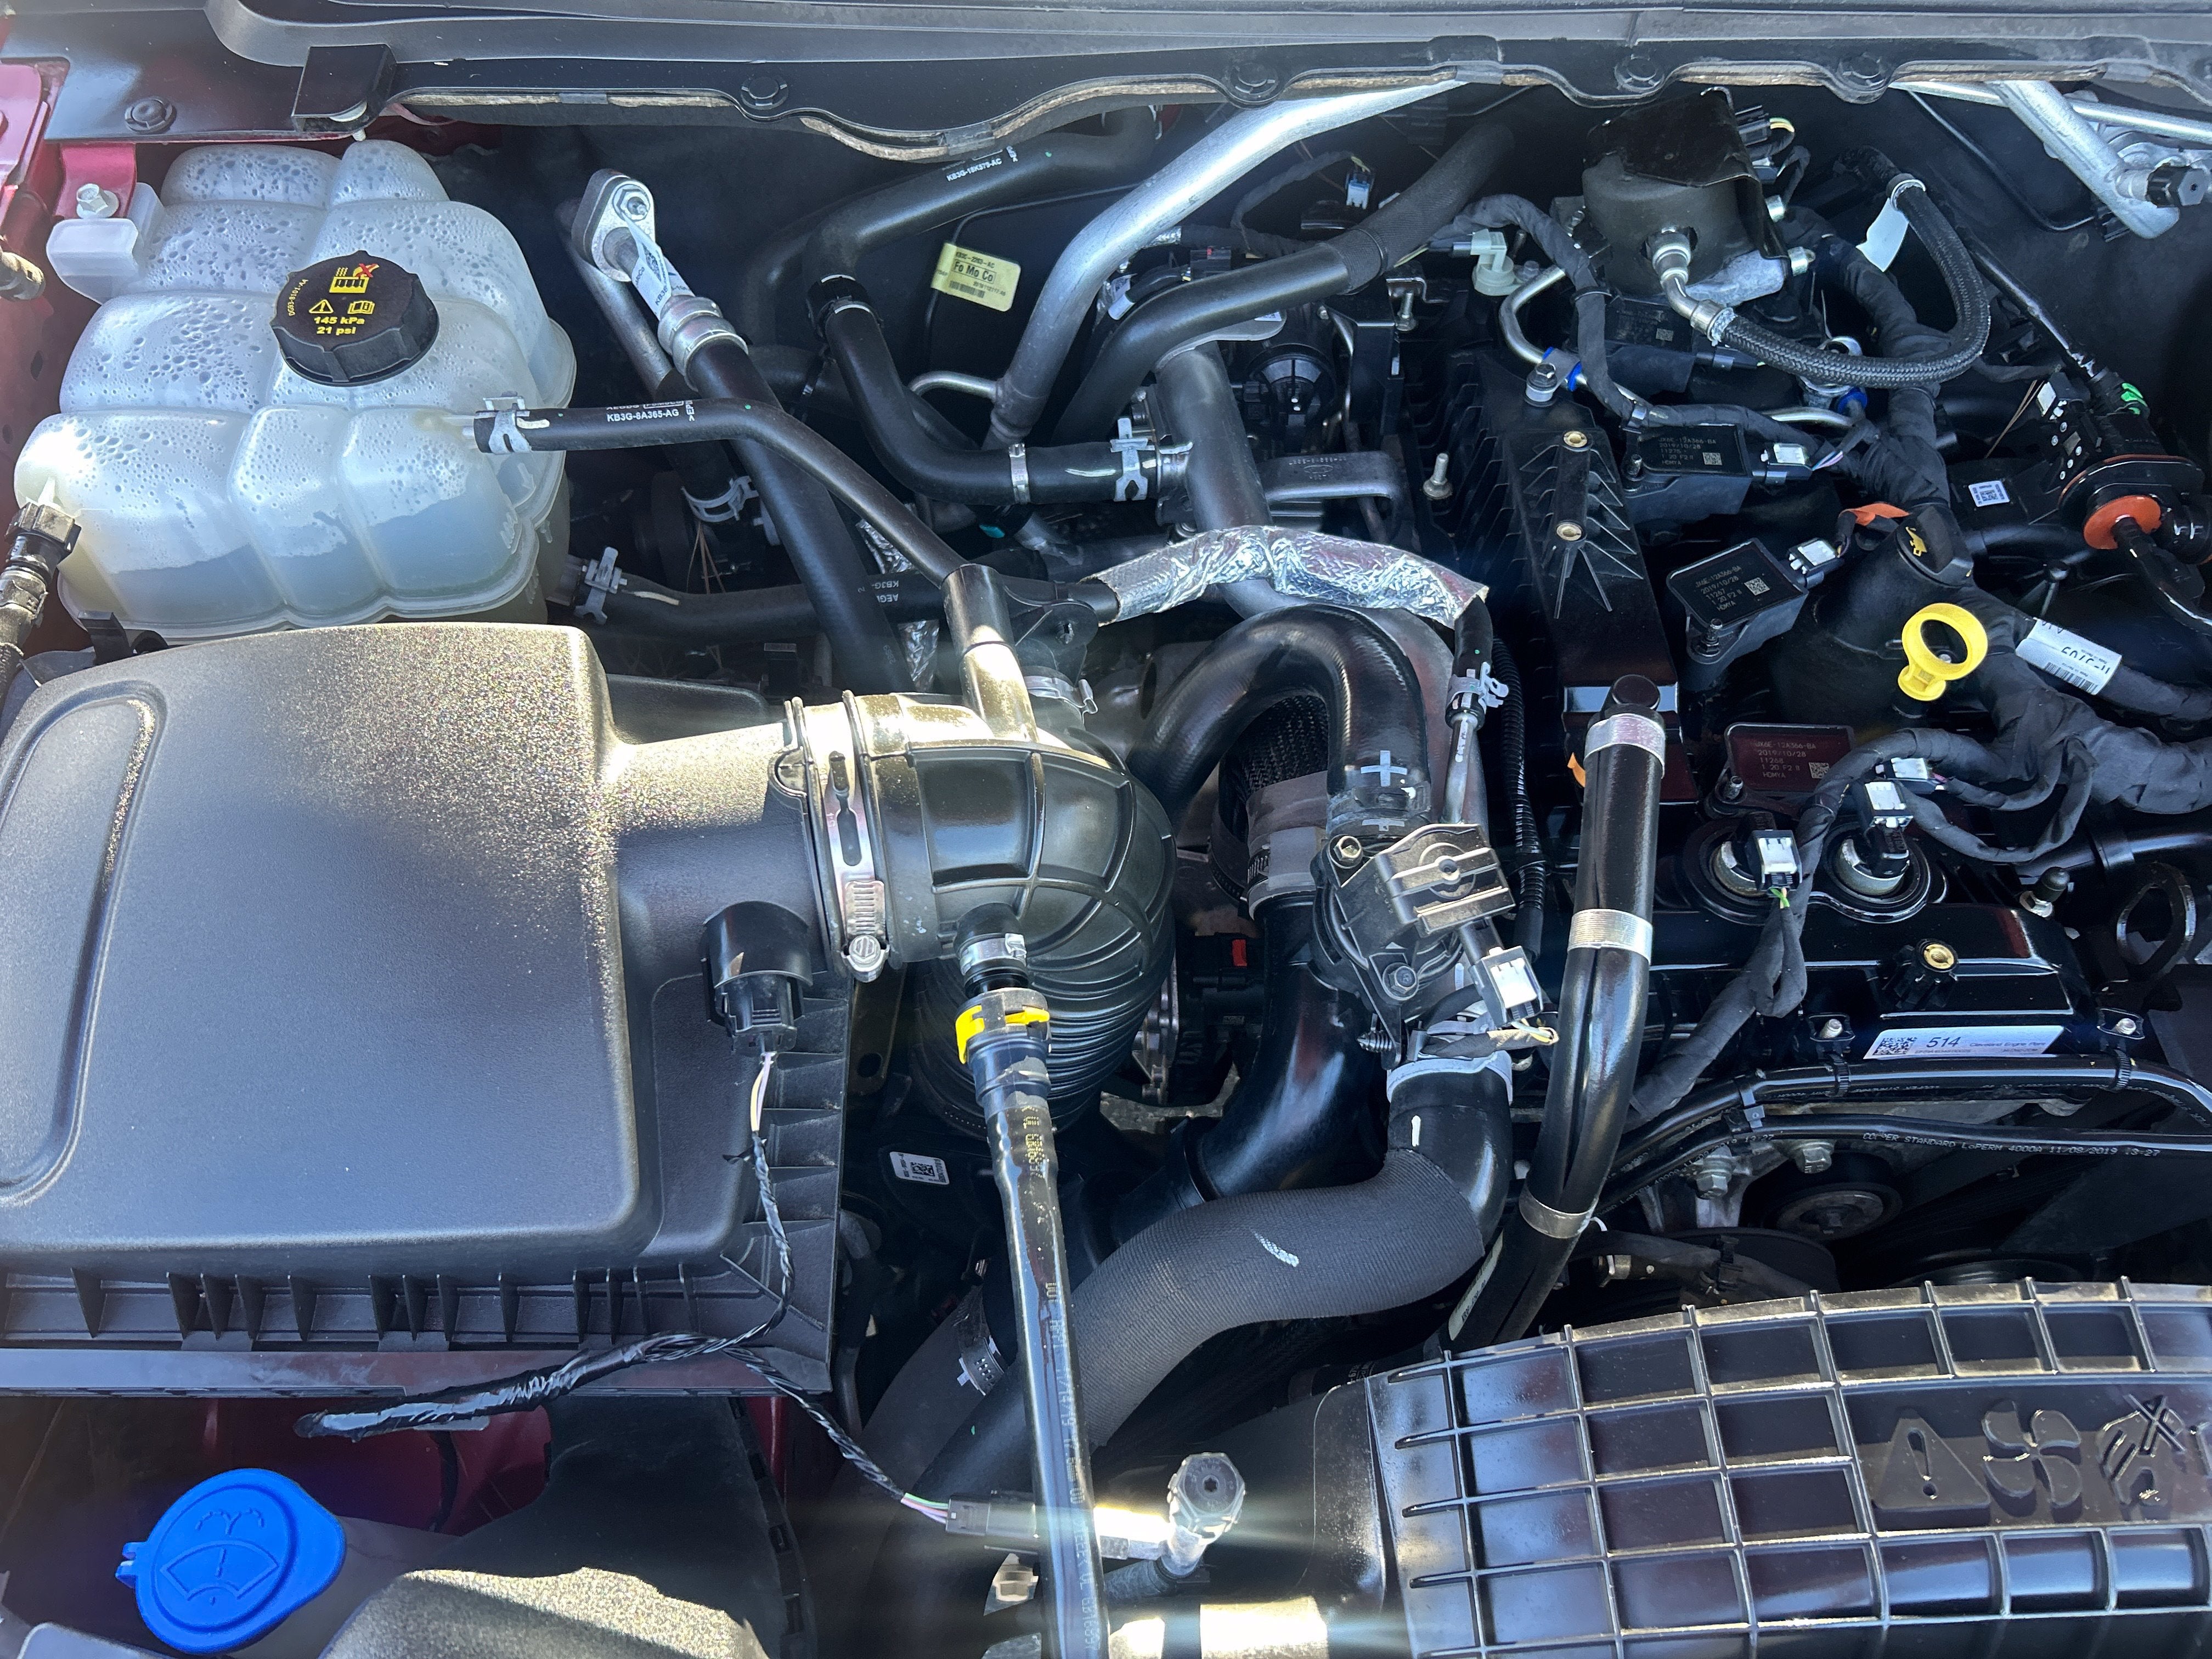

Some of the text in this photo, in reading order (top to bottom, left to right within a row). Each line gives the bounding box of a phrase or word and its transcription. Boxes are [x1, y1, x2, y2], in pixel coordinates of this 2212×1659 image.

[955, 261, 994, 283] Fo Mo Co
[336, 326, 357, 336] psi
[607, 409, 679, 422] KB3G-8A365-AG
[1926, 1036, 1961, 1047] 514
[1904, 1136, 1956, 1148] STANDARD
